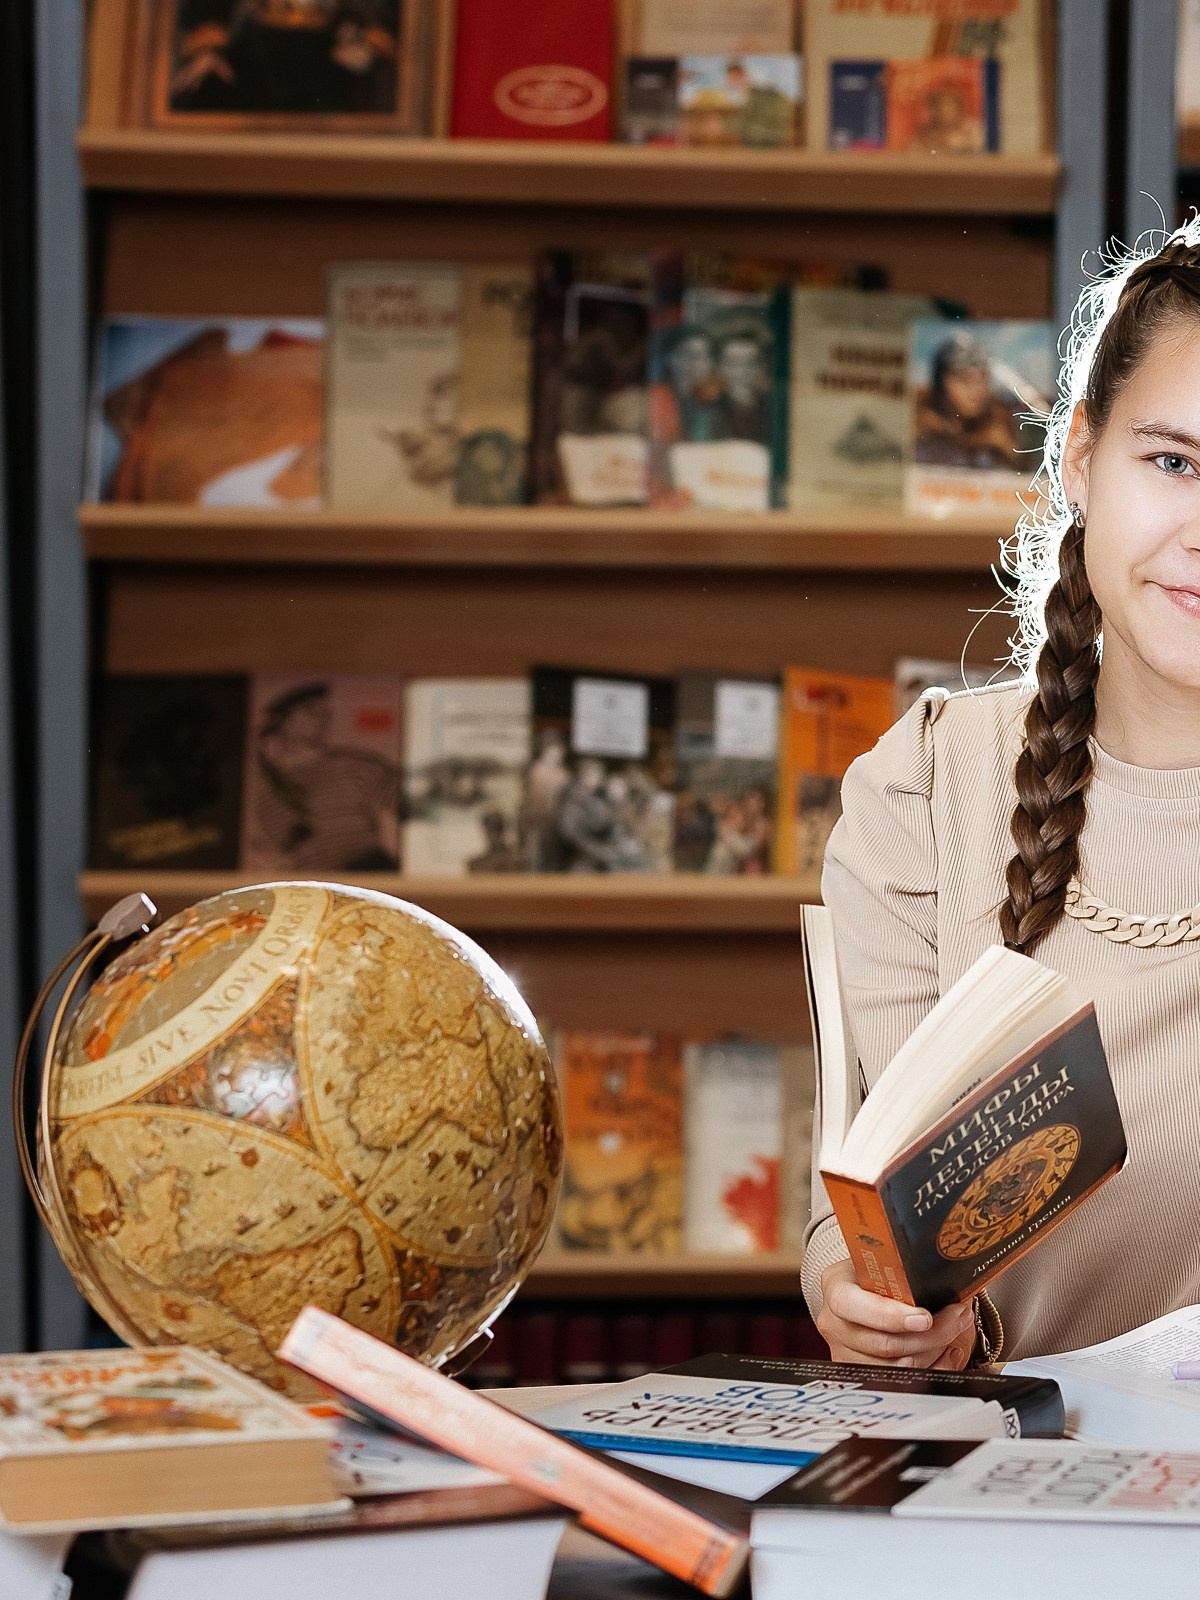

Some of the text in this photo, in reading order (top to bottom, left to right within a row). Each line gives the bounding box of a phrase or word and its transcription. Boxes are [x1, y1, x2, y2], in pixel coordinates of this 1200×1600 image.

[201, 960, 268, 1022] NOVI
[913, 1065, 1071, 1208] ЛЕГЕНДЫ
[928, 1060, 1043, 1165] МИФЫ
[916, 1133, 1013, 1217] НАРОДОВ
[1020, 1084, 1076, 1132] МИРА
[972, 1194, 1072, 1278] Древняя Греция
[582, 1409, 857, 1444] СЛОВАРЬ
[617, 1401, 880, 1428] НОВЕЙШИХ
[631, 1392, 913, 1420] ИНОСТРАННЫХ
[715, 1385, 883, 1407] СЛОВ
